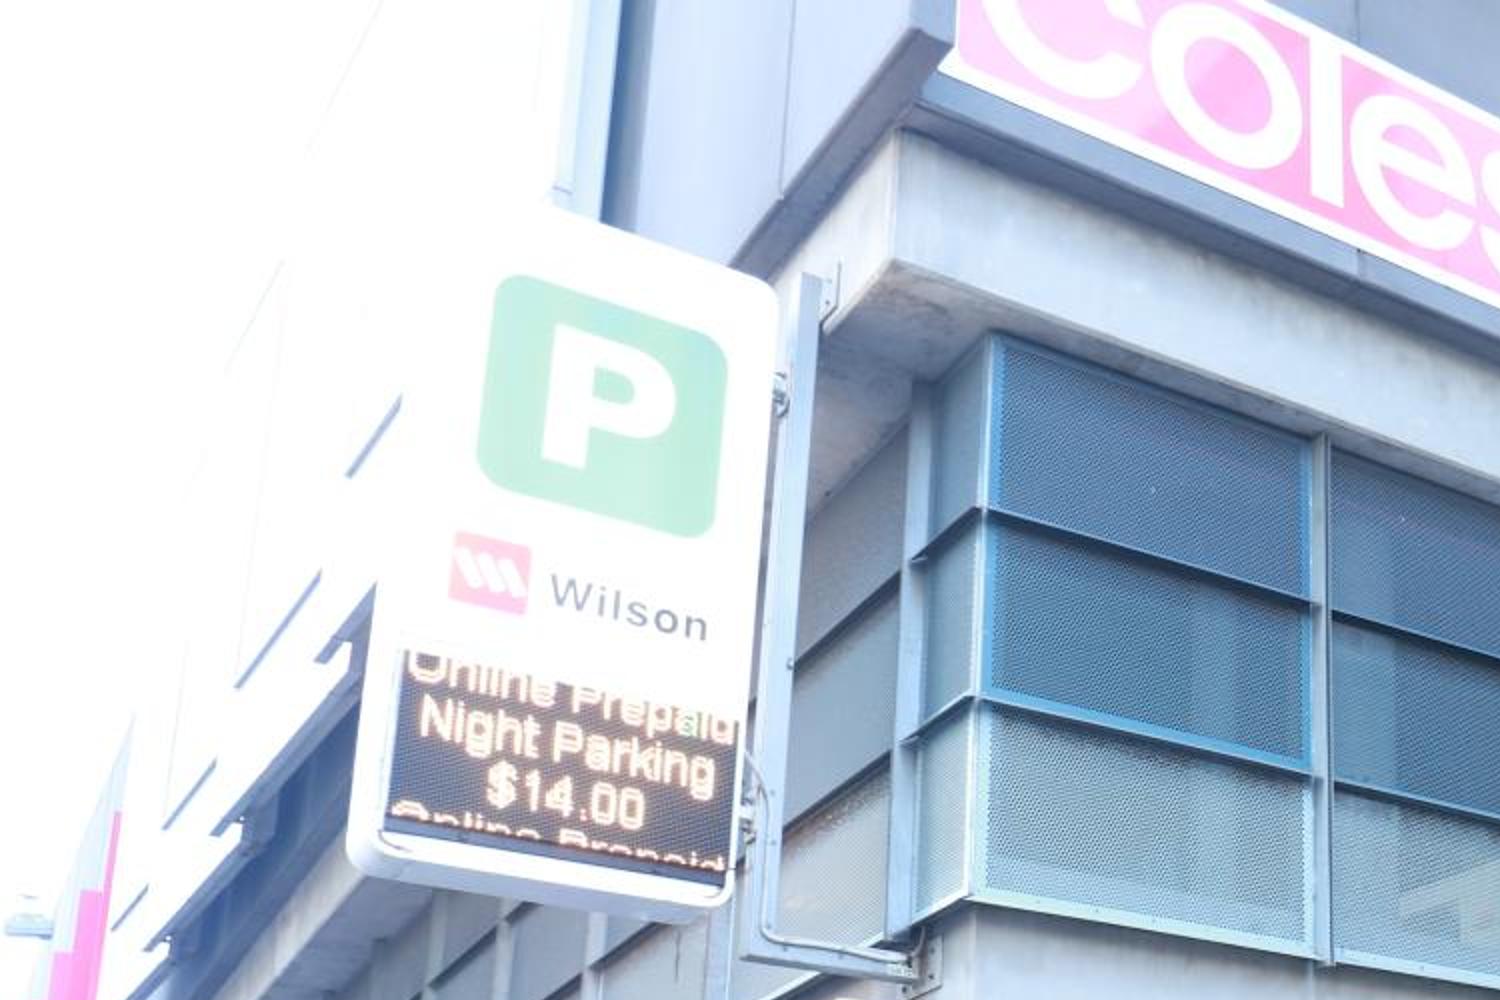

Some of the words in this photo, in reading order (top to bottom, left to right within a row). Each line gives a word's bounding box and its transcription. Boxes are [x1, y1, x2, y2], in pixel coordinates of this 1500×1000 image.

[540, 322, 677, 471] P
[549, 572, 709, 642] Wilson
[420, 692, 541, 759] Night
[553, 721, 716, 801] Parking
[486, 759, 646, 831] $14.00
